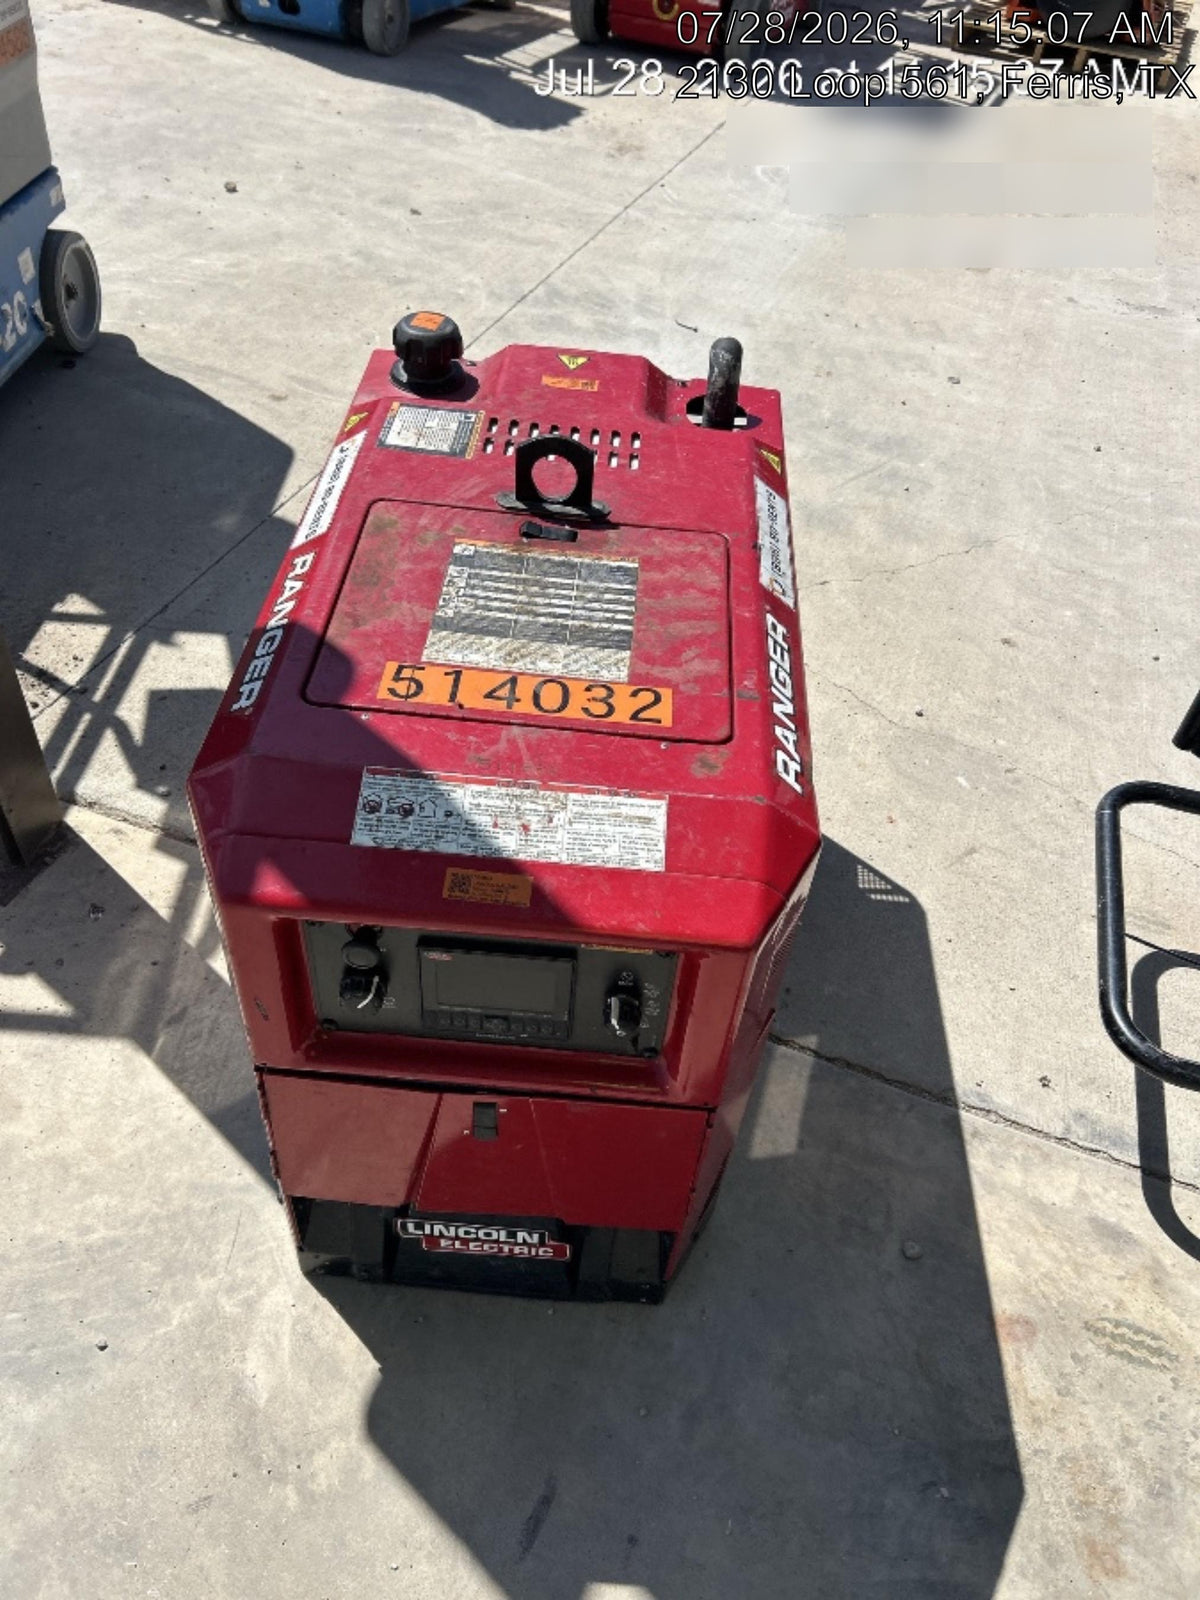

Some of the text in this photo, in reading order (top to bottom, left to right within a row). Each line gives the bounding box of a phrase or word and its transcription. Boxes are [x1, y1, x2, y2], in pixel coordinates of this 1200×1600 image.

[230, 552, 316, 712] RANGER
[386, 664, 663, 724] 514032
[765, 612, 804, 794] RANGER
[406, 1222, 540, 1244] LINCOLN
[440, 1238, 554, 1256] ELECTRIC
